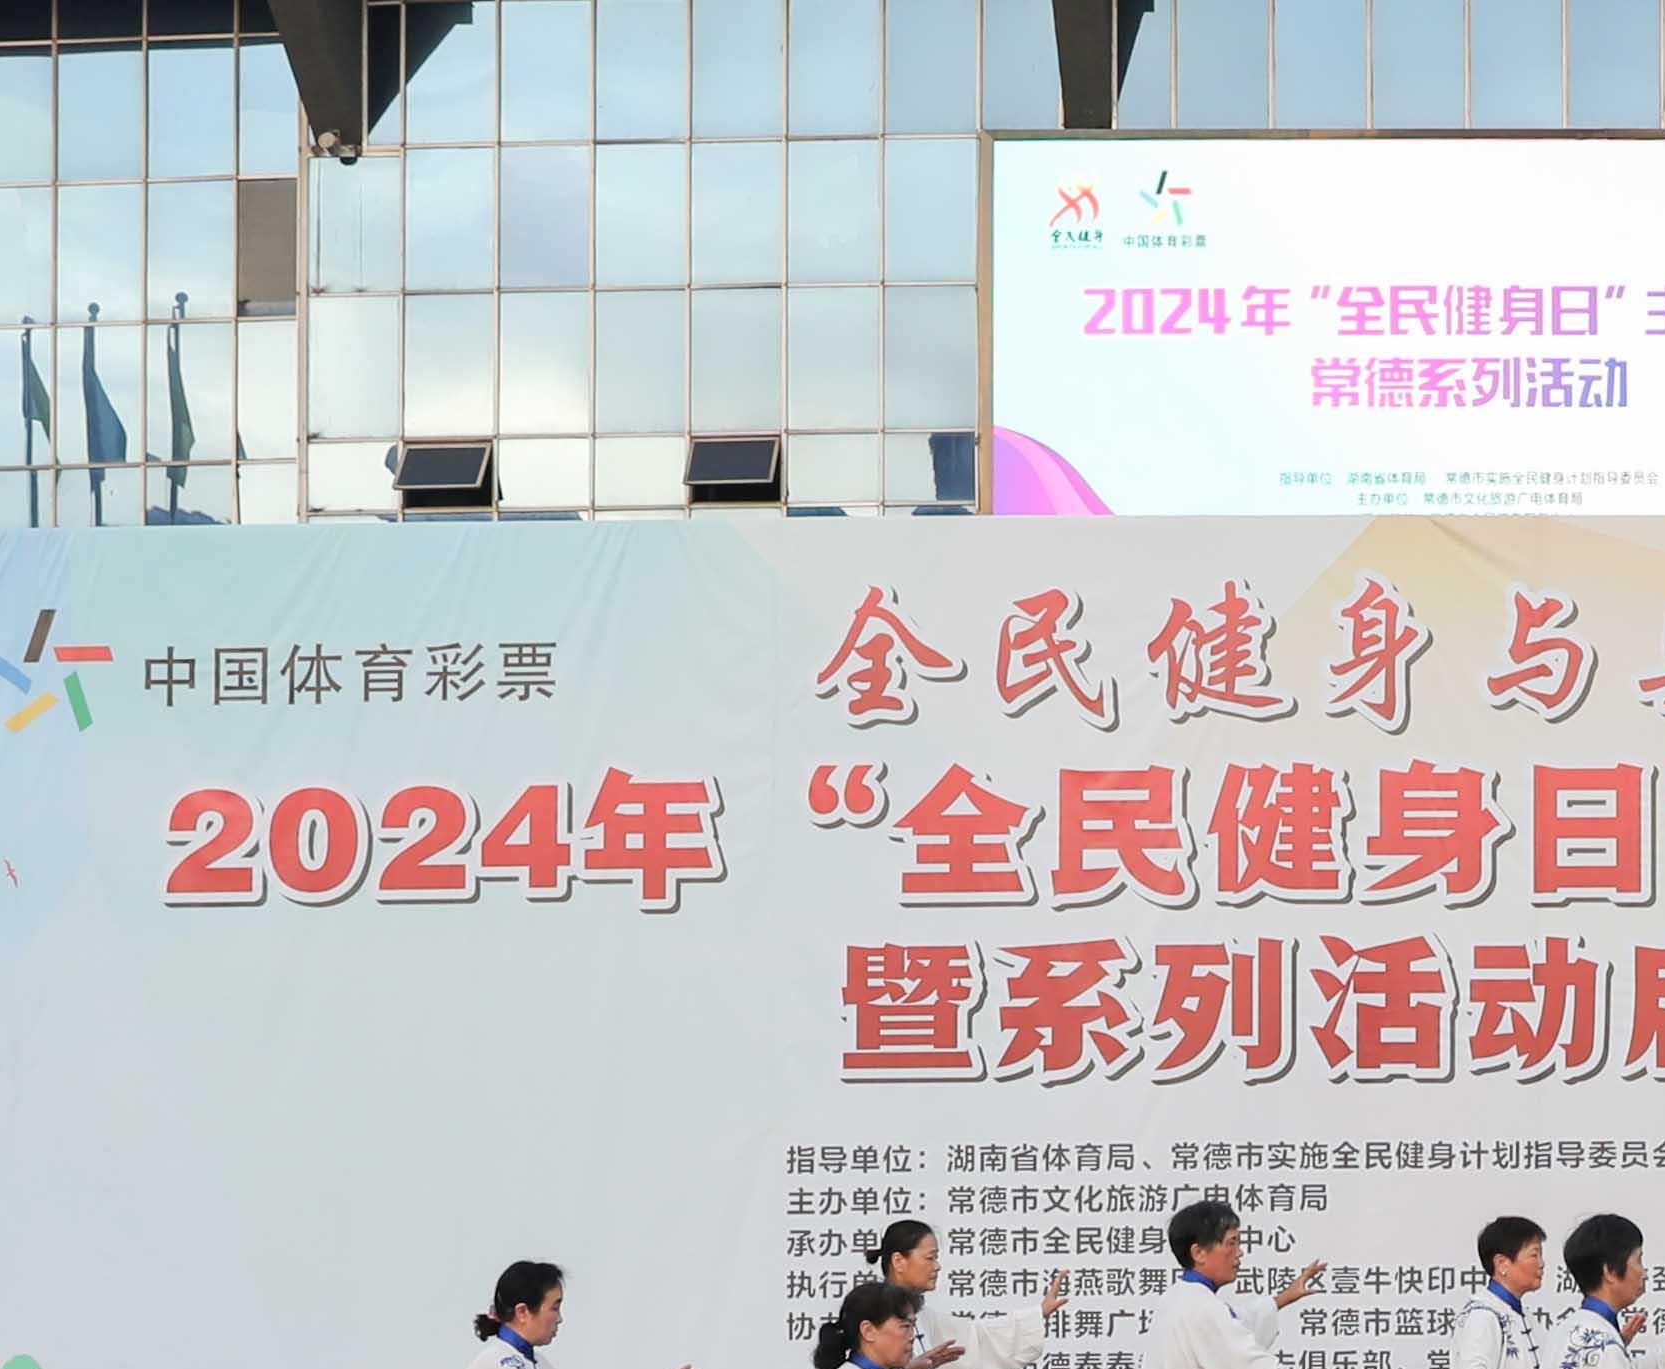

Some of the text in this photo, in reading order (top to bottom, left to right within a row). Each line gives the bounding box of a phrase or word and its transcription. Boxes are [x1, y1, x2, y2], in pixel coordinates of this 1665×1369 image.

[1123, 234, 1207, 247] 中国体育彩票
[1310, 356, 1629, 409] 常德系列活动
[144, 641, 557, 707] 中国体育彩票
